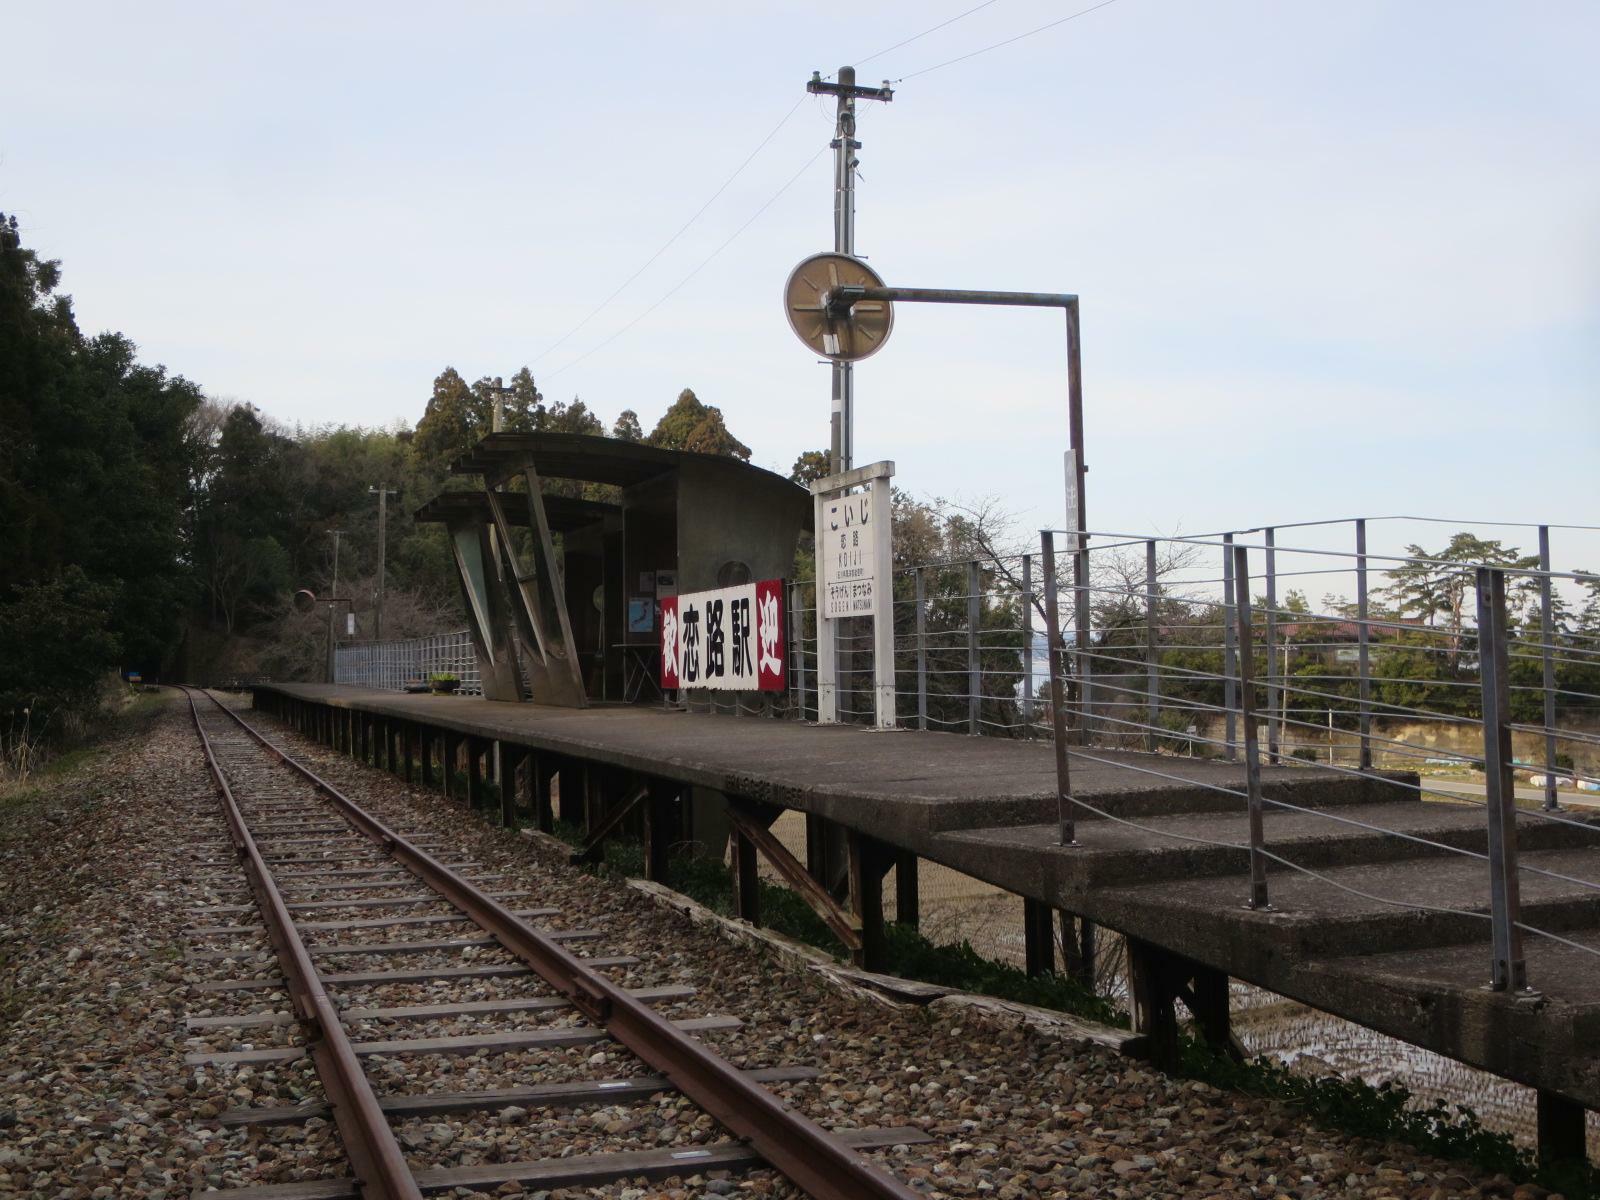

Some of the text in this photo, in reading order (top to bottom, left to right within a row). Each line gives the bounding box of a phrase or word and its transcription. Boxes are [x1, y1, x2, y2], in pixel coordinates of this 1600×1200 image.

[830, 498, 869, 531] こいじ
[838, 550, 862, 568] KOIJI
[682, 597, 753, 682] 恋路駅
